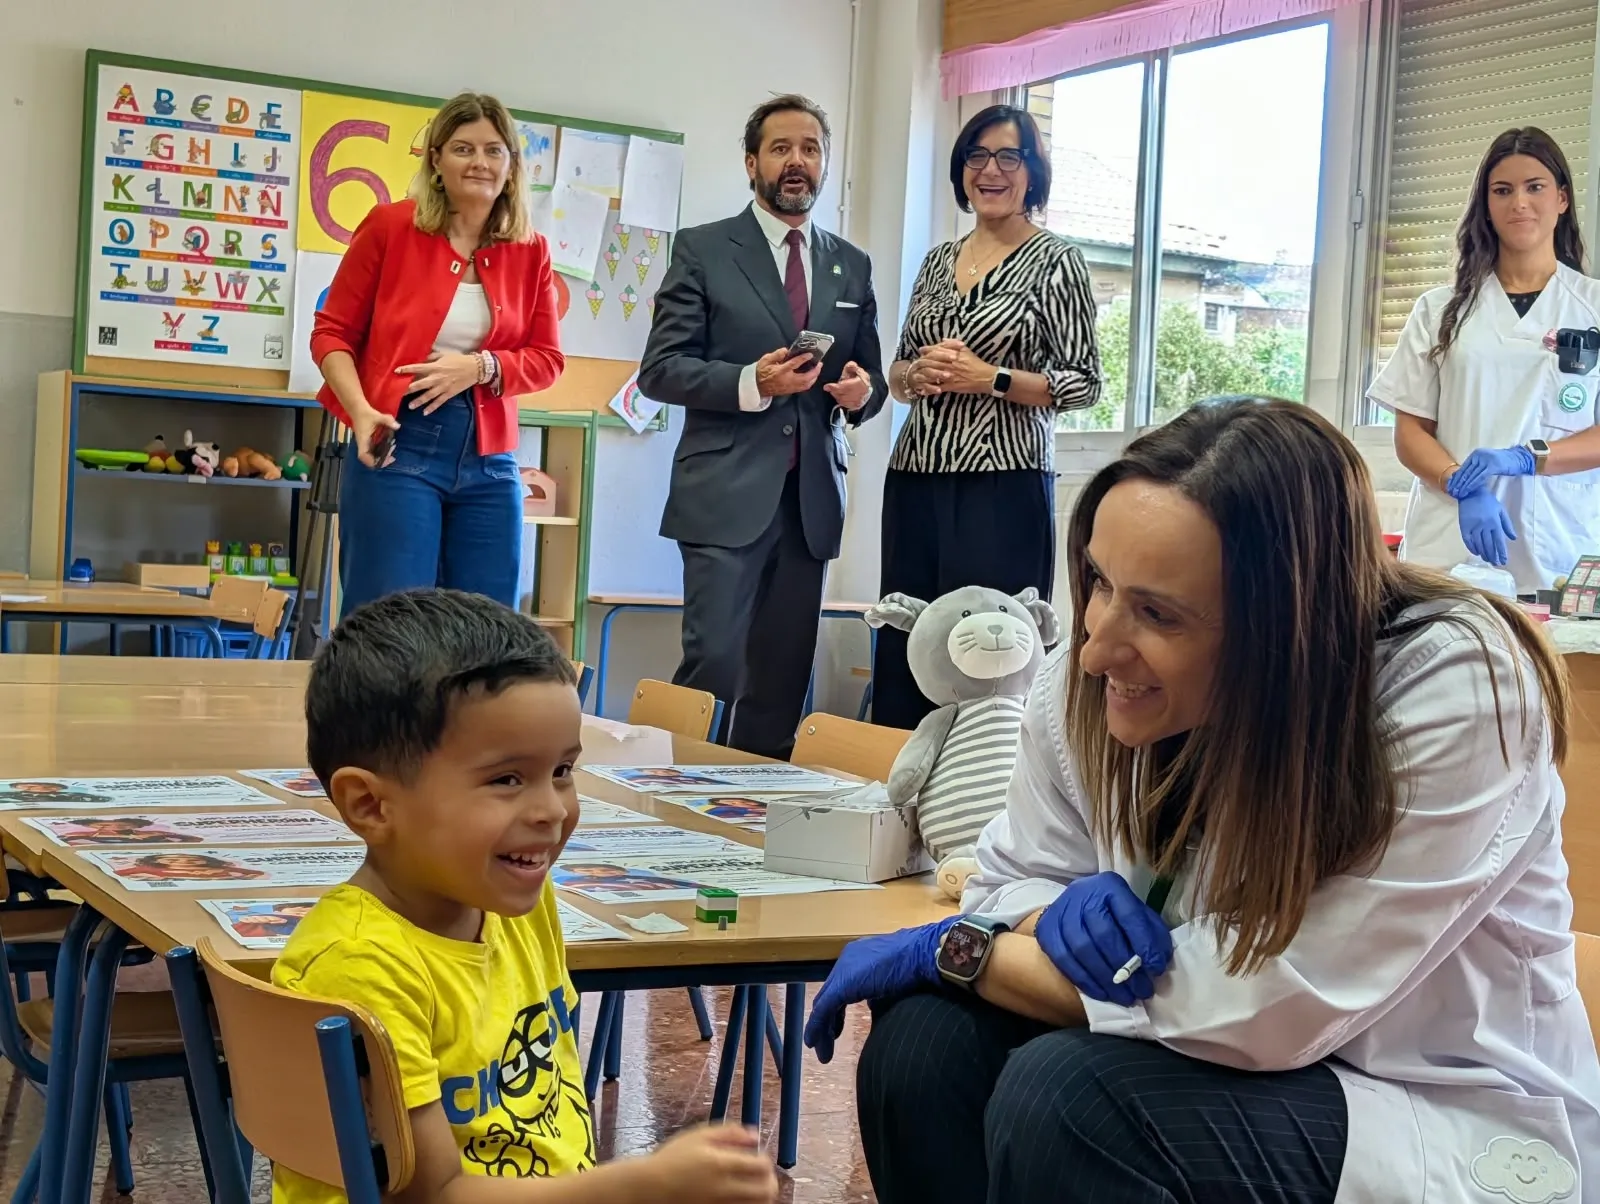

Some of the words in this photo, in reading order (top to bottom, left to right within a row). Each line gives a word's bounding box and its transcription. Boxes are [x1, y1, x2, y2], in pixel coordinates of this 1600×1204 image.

[113, 83, 140, 112] A
[154, 88, 175, 116] B
[191, 95, 213, 122] C
[226, 97, 250, 124] D
[265, 103, 282, 130] E
[118, 129, 135, 154] F
[150, 133, 174, 161] G
[189, 137, 211, 165] H
[265, 147, 278, 173] J
[112, 174, 135, 201] K
[154, 178, 170, 205] L
[183, 181, 213, 209] M
[224, 185, 249, 212] N
[309, 119, 392, 247] 6
[108, 218, 135, 245] O
[150, 218, 170, 249] P
[184, 226, 210, 257] Q
[224, 229, 243, 257] R
[261, 233, 278, 260] S
[109, 263, 131, 288] T
[146, 266, 169, 293] U
[184, 269, 207, 295] V
[215, 271, 250, 300] W
[256, 276, 279, 303] X
[162, 311, 186, 339] Y
[200, 315, 220, 342] Z
